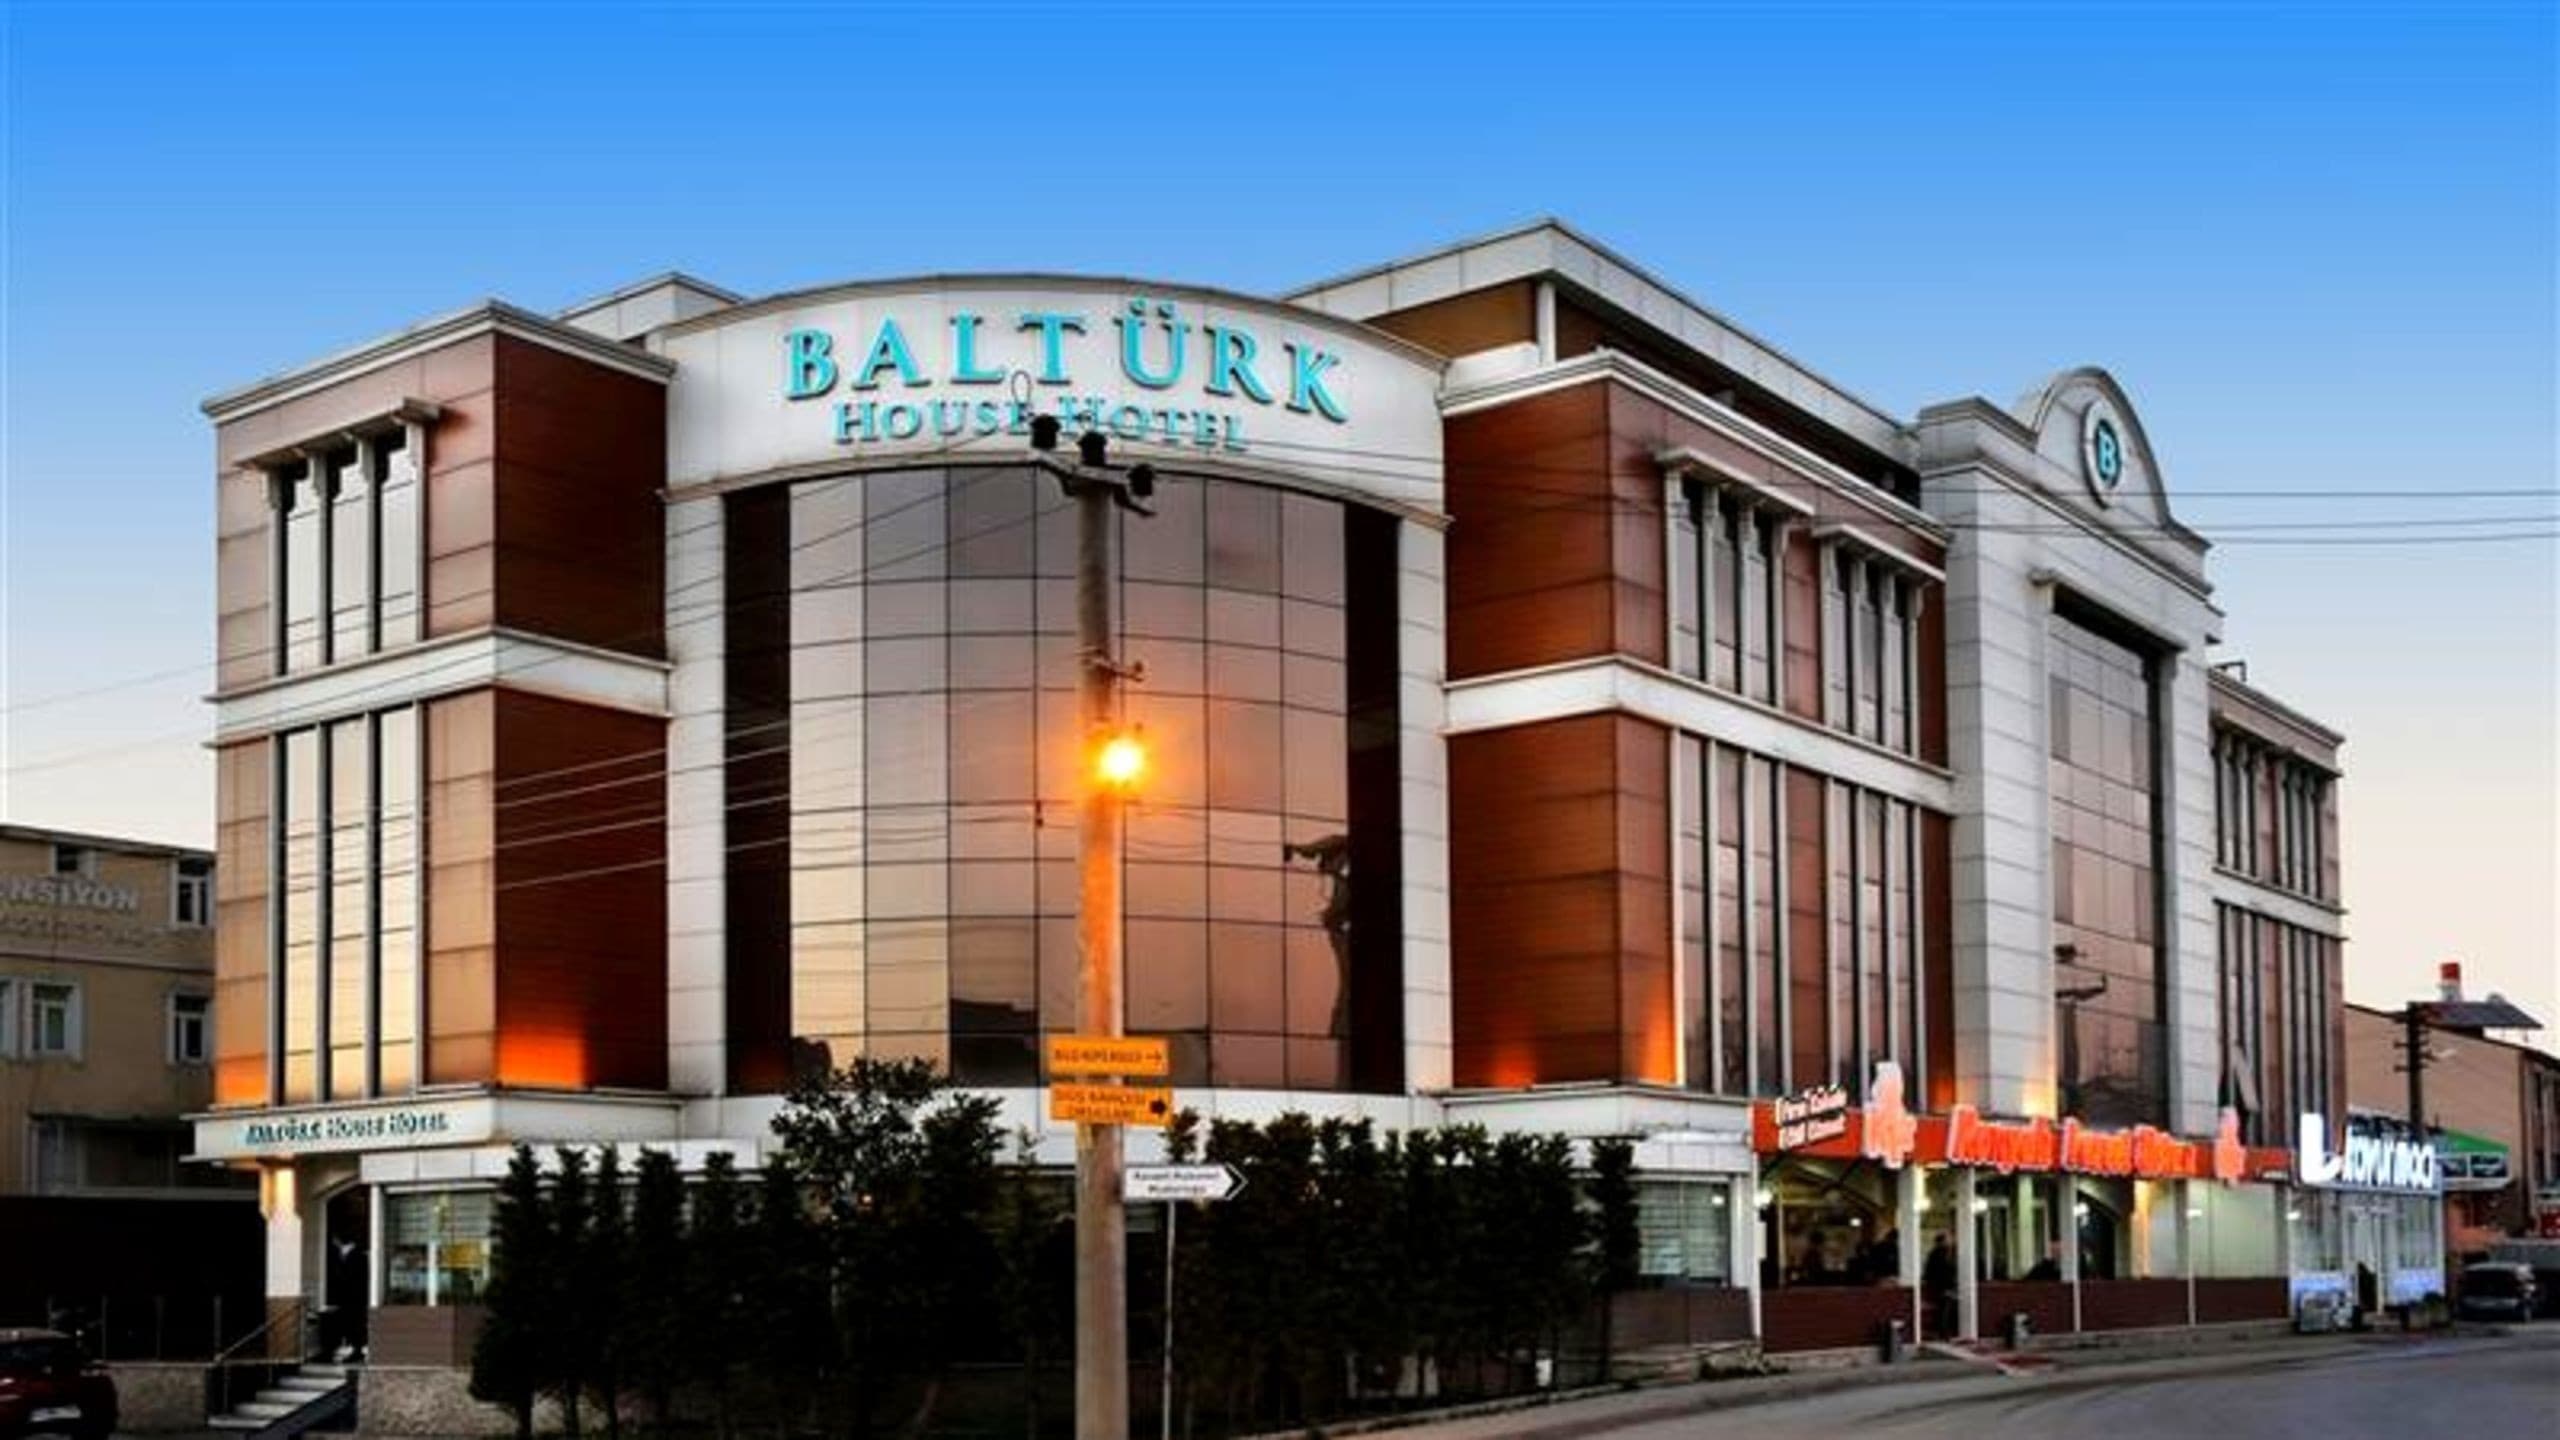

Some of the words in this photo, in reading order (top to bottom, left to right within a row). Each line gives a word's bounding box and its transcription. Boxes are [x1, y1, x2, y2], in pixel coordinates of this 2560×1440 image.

[783, 299, 1348, 423] BALTÜRK
[834, 399, 1036, 445] HOUSE
[1058, 397, 1250, 453] HOTEL
[2097, 429, 2118, 479] B
